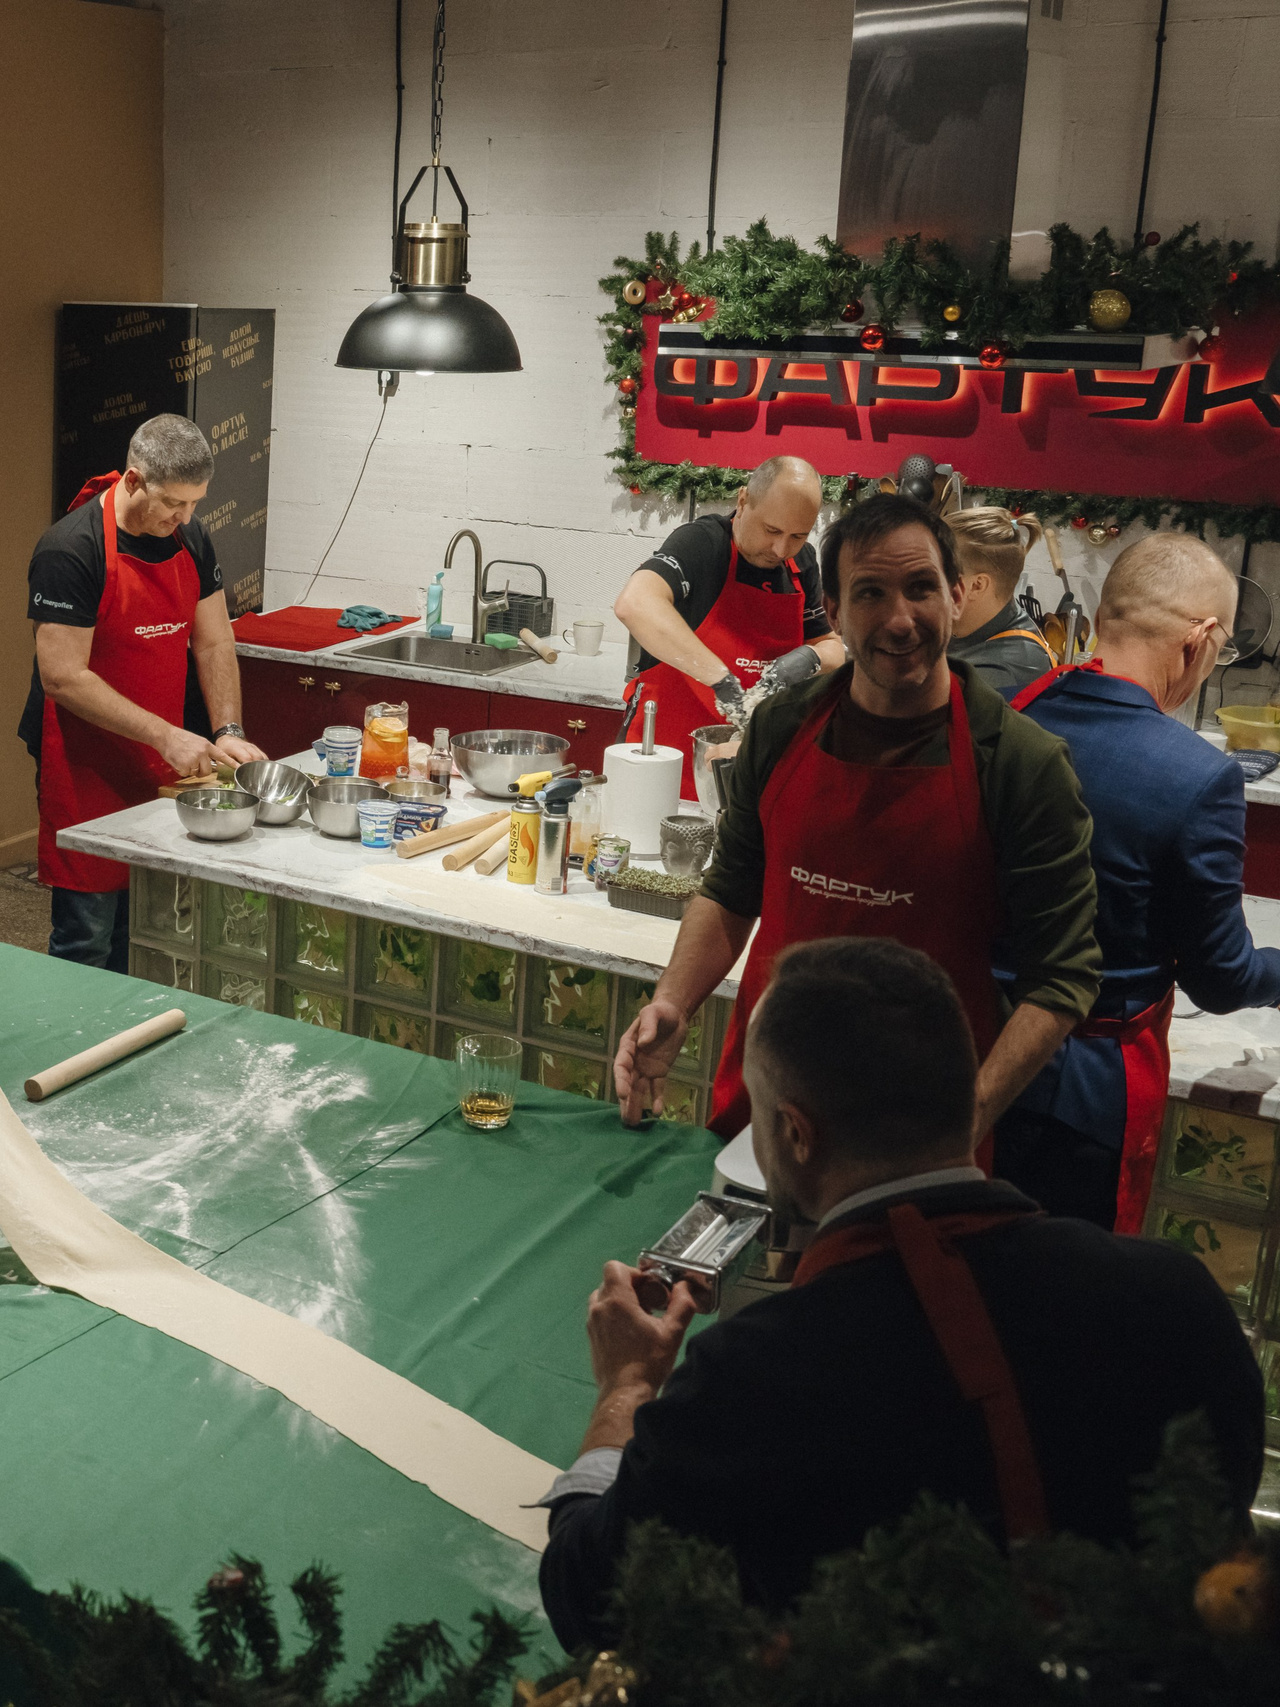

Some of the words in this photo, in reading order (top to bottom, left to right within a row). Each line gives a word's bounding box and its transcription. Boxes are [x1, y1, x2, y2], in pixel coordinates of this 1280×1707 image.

[175, 359, 212, 384] ВКУСНО
[654, 356, 1280, 427] ФАРТУК
[211, 411, 246, 440] ФАРТУК
[220, 425, 249, 451] МАСЛЕ!
[233, 569, 260, 594] ОСТРЕЕ!
[134, 621, 188, 635] ФАРТУК
[509, 839, 518, 863] GAS
[790, 866, 914, 905] ФАРТУК
